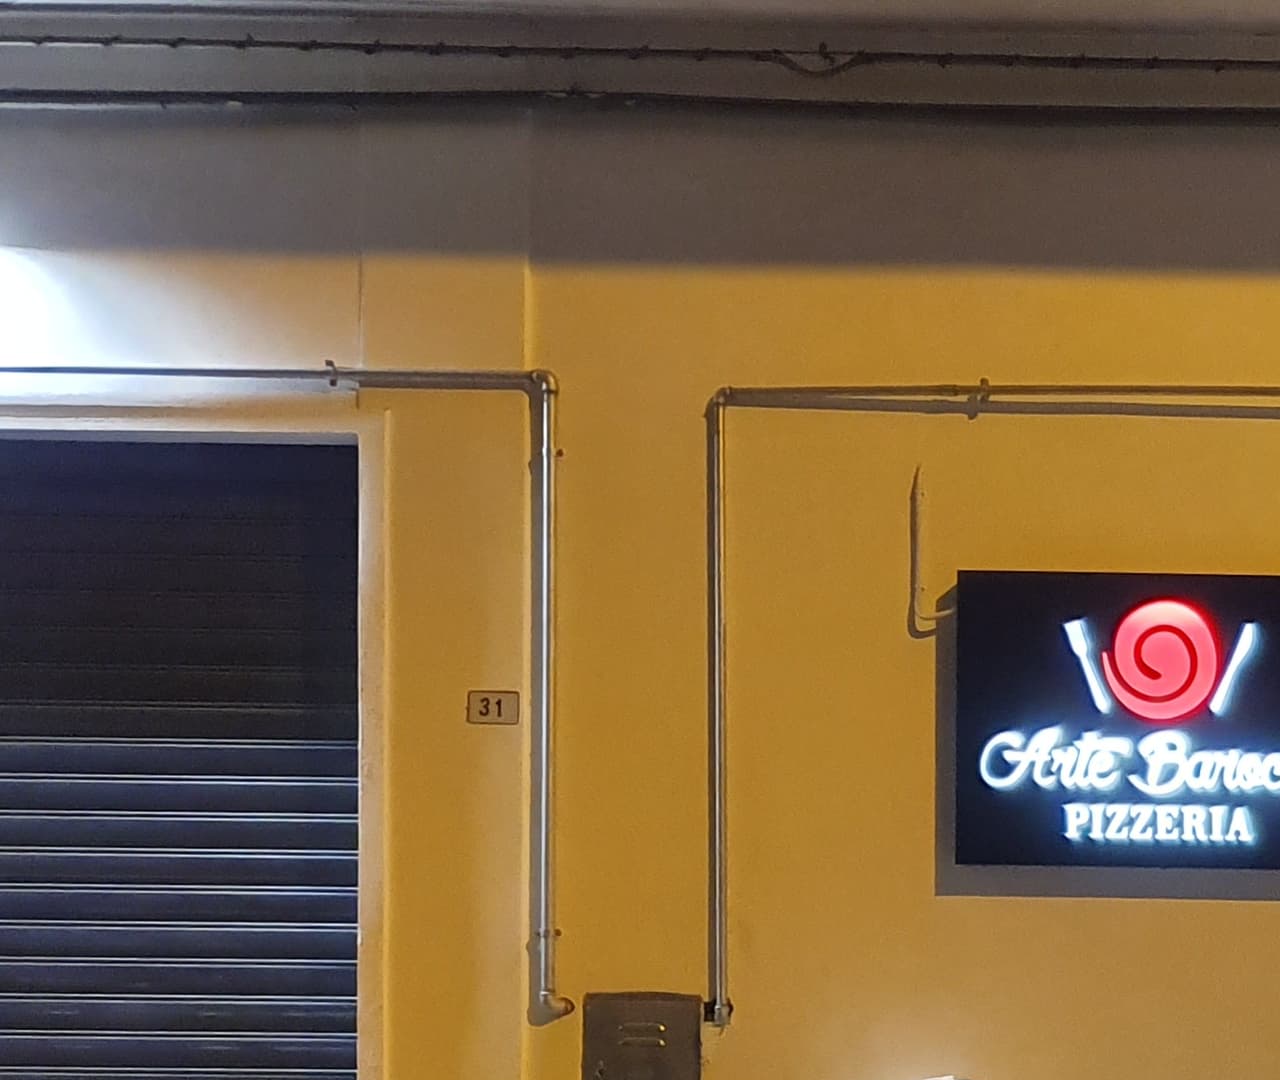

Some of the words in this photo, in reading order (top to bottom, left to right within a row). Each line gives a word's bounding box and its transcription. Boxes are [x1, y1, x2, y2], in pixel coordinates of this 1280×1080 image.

[478, 696, 503, 718] 31
[978, 725, 1132, 792] Arte
[1062, 802, 1256, 843] PIZZERIA
